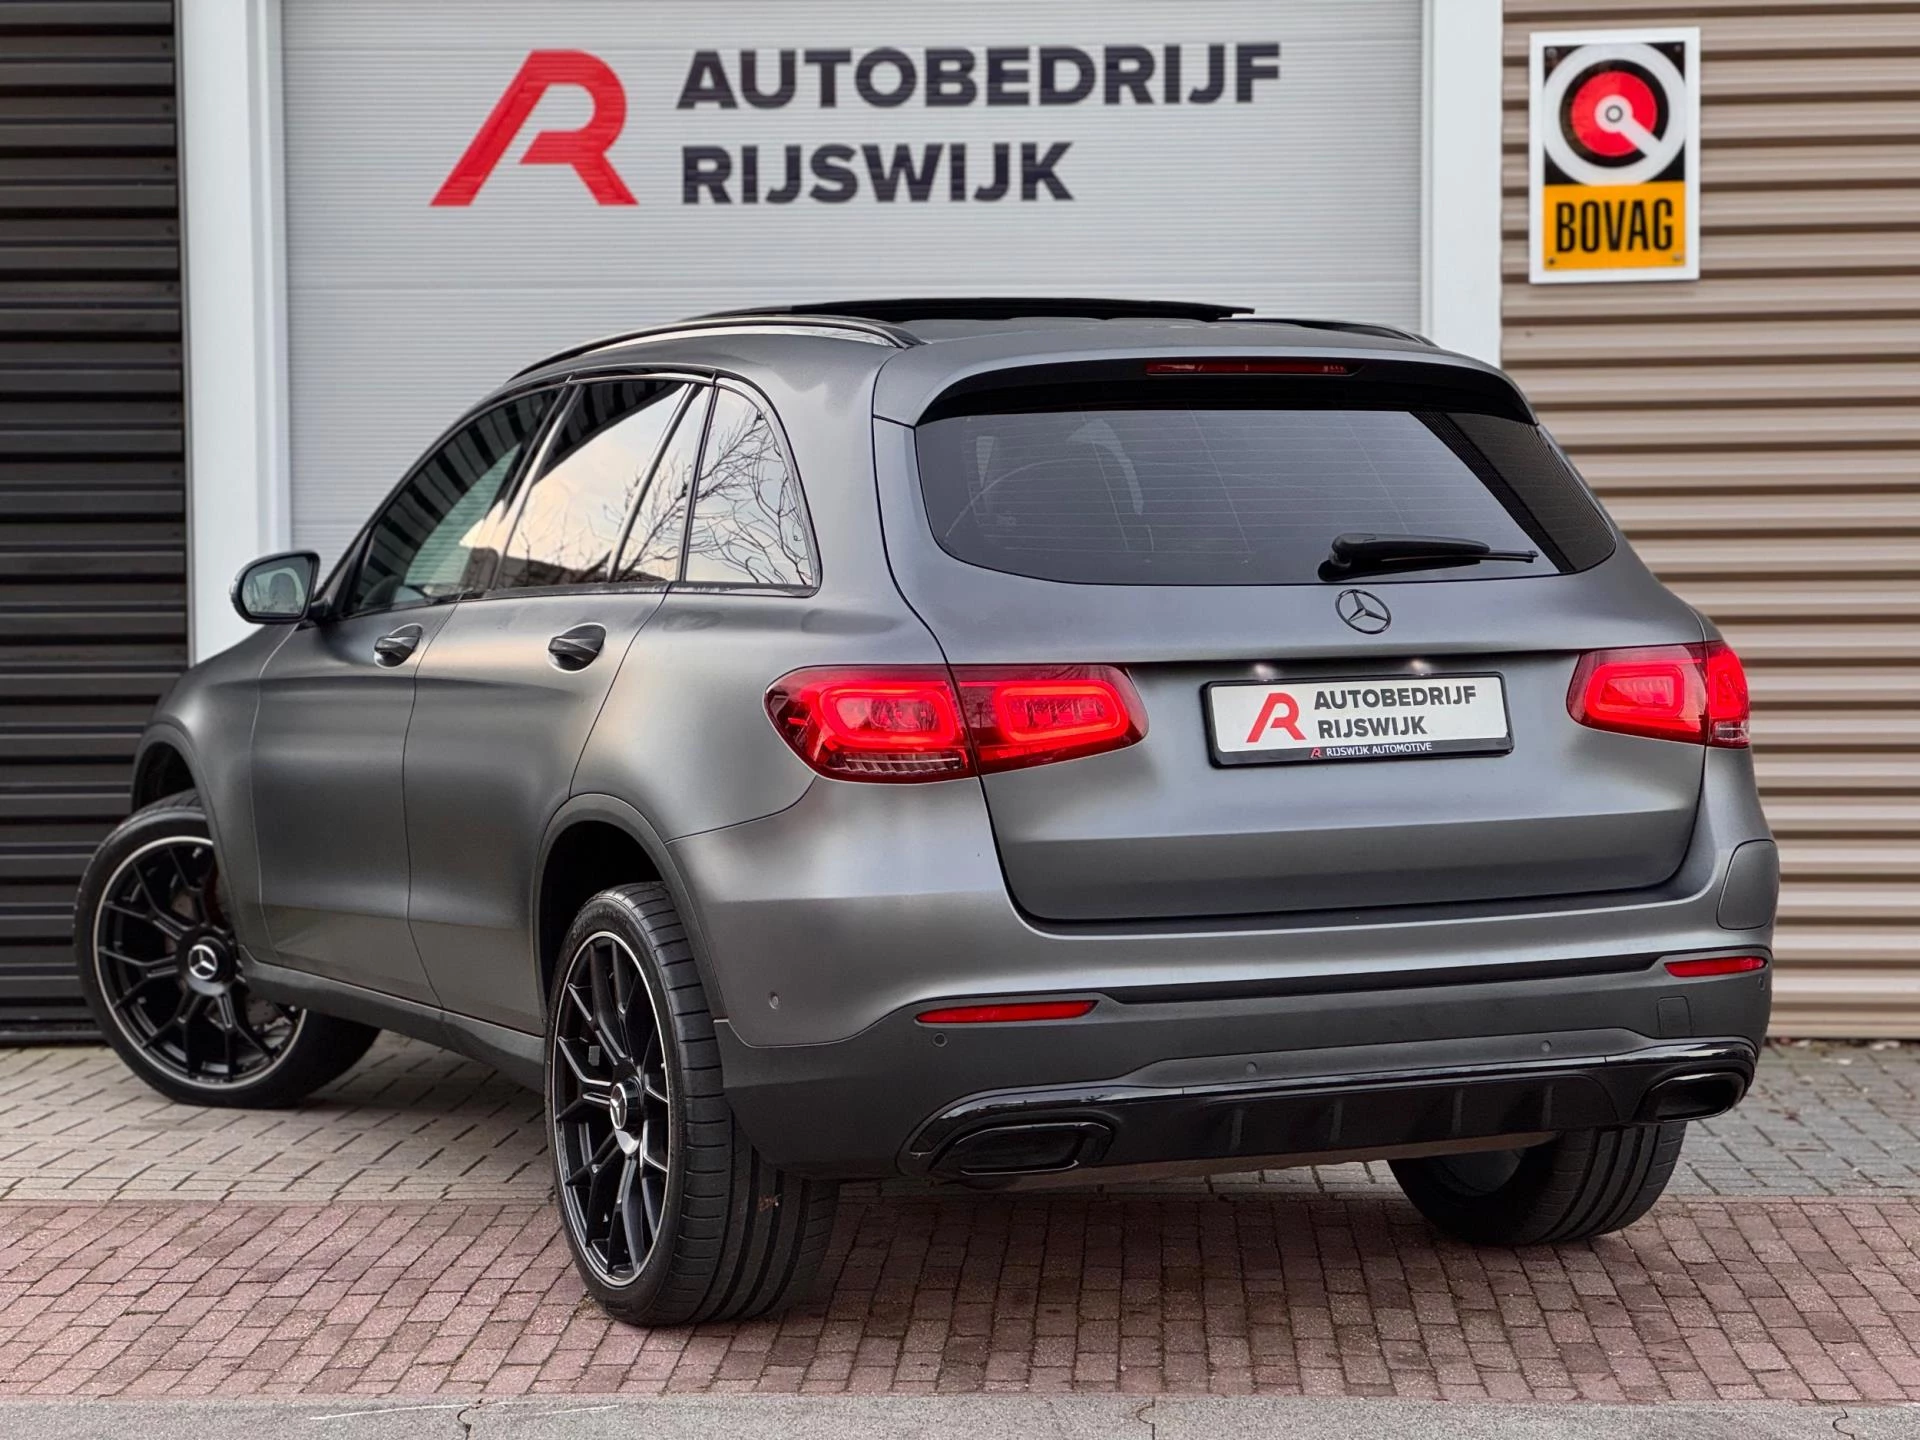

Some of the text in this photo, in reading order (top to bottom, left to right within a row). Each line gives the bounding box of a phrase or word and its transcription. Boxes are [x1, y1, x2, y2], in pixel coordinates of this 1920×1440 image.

[677, 43, 1281, 109] AUTOBEDRIJF
[681, 142, 1073, 204] RIJSWIJK
[1556, 198, 1673, 252] BOVAG
[1314, 686, 1477, 710] AUTOBEDRIJF
[1317, 716, 1428, 739] RIJSWIJK
[1326, 746, 1370, 757] RIJSWIJK
[1372, 742, 1433, 754] AUTOMOTIVE
